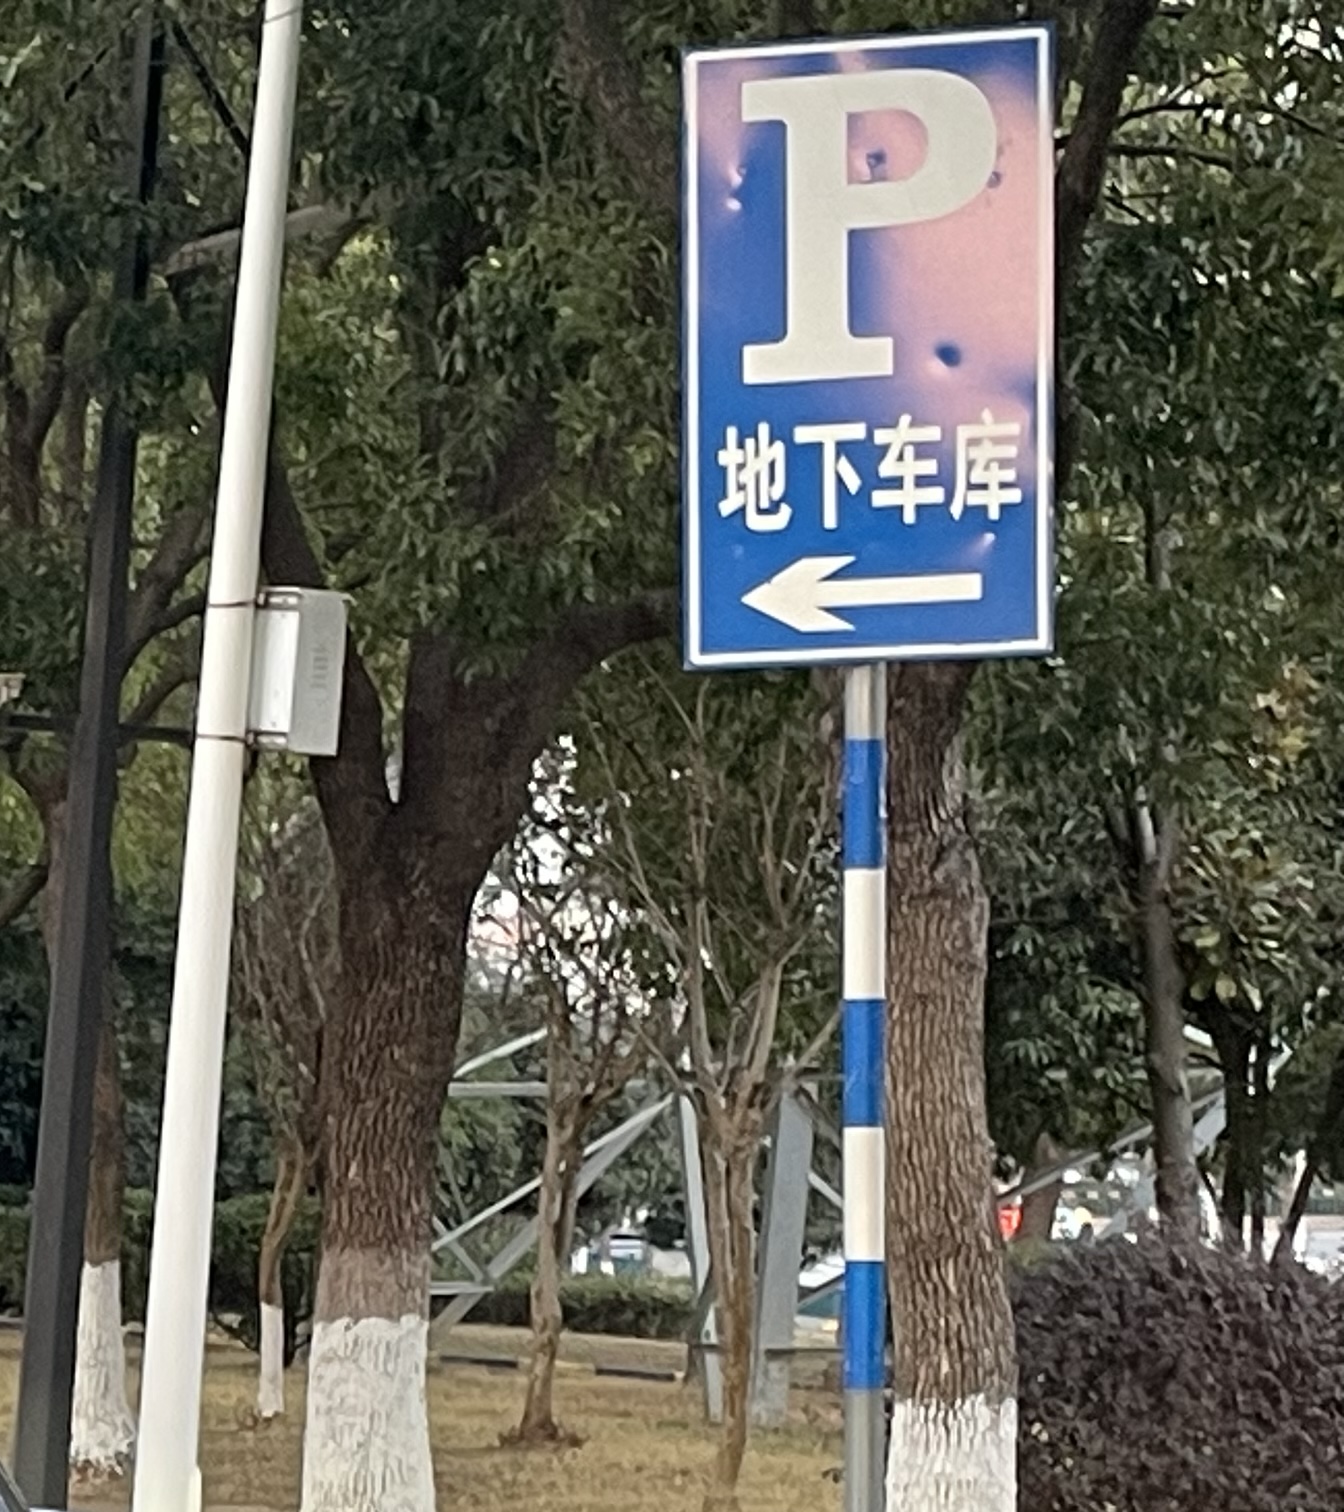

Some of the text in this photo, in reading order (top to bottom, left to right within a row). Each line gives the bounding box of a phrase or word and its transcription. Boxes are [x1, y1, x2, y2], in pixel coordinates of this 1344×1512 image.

[740, 67, 998, 385] P
[717, 408, 1022, 531] 地下车库
